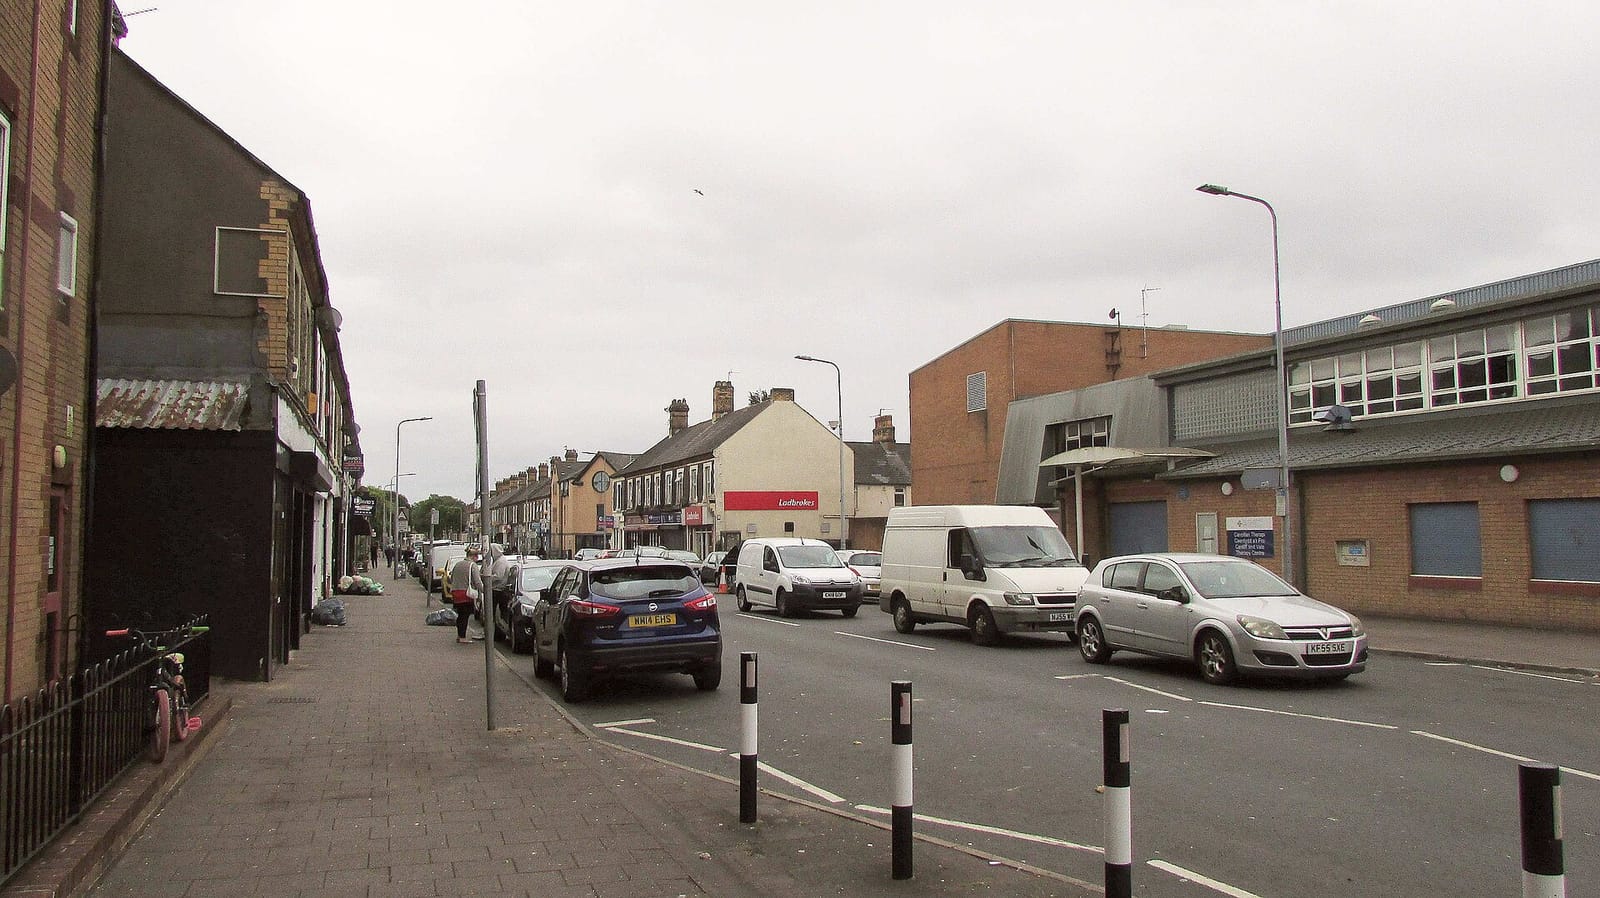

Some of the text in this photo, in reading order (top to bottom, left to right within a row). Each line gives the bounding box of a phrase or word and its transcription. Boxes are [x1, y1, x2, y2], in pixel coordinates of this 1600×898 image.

[778, 499, 815, 507] Ladbrokes
[655, 614, 672, 624] EHS
[1310, 643, 1345, 653] KF55 SXE
